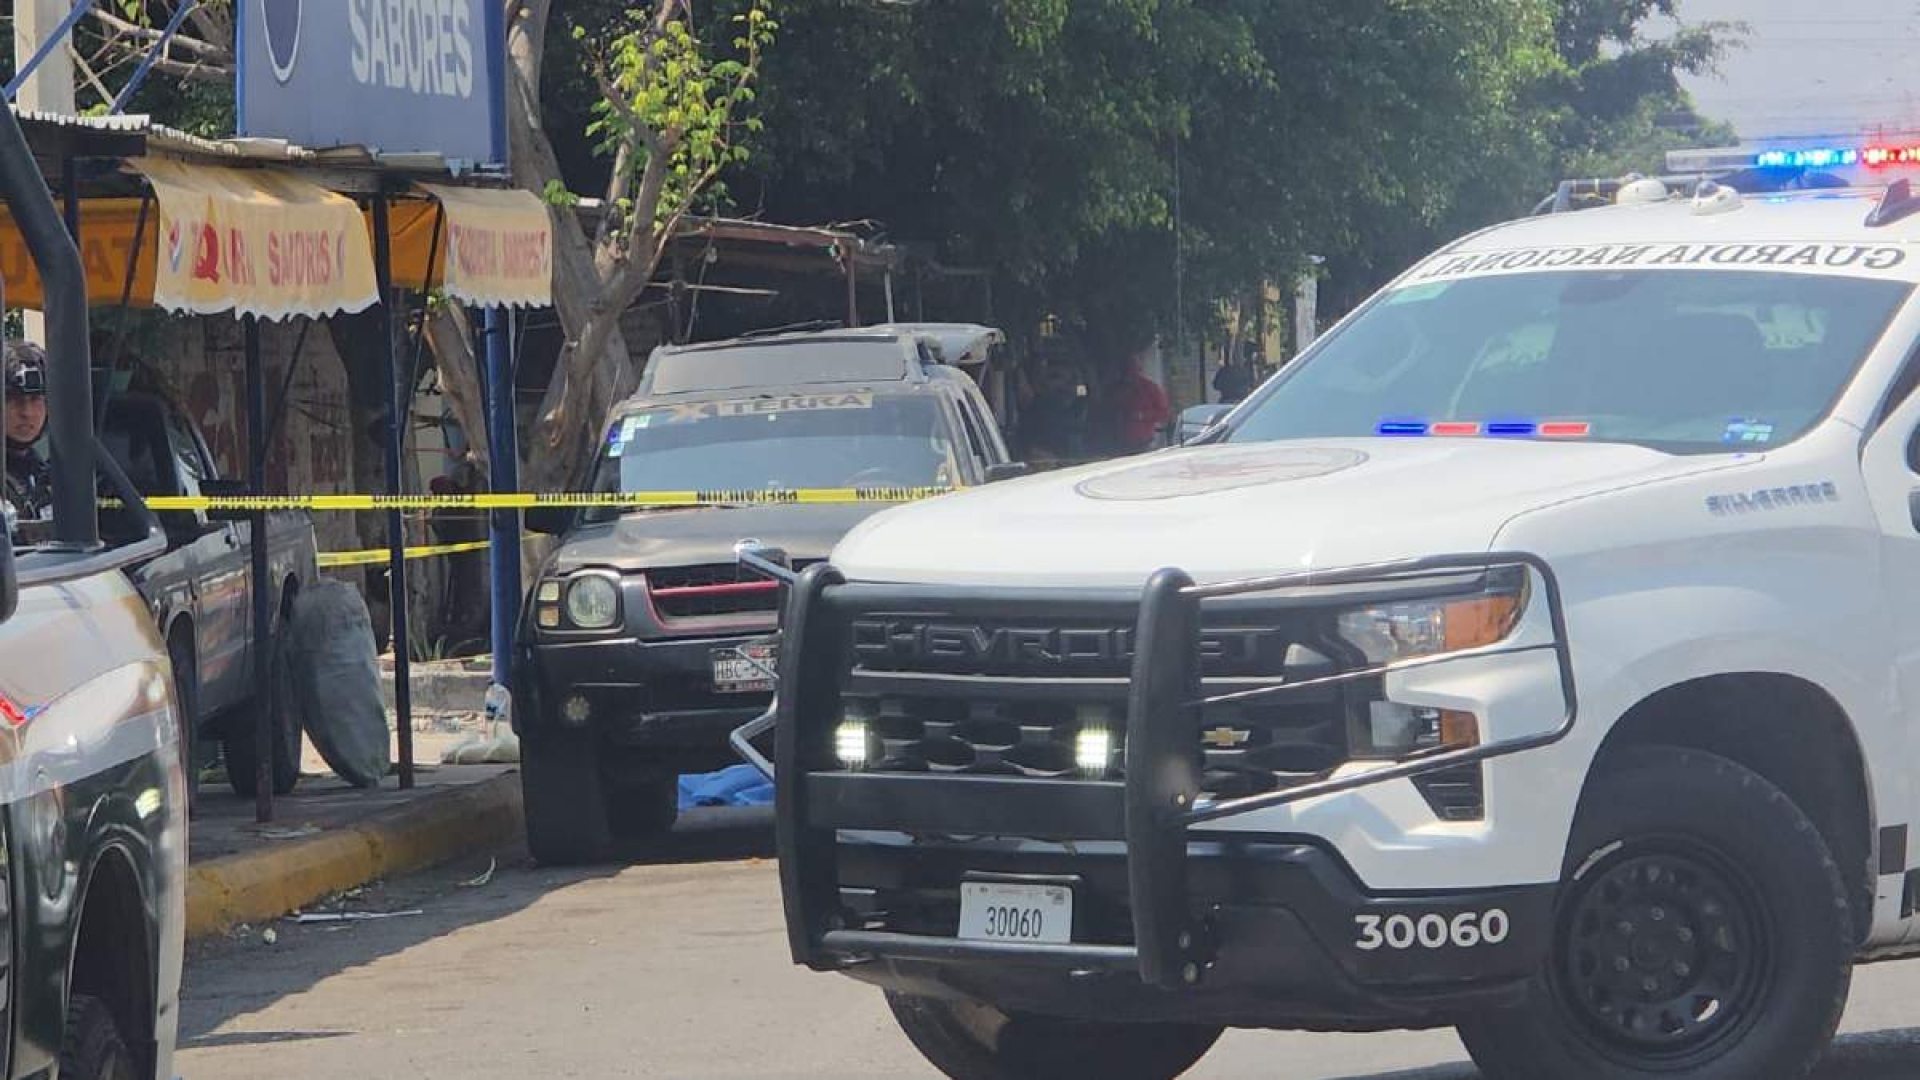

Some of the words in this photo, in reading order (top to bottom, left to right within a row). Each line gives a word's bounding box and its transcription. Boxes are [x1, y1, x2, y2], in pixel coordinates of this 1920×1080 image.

[348, 0, 473, 99] SABORES
[985, 906, 1042, 938] 30060
[1354, 908, 1510, 950] 30060
